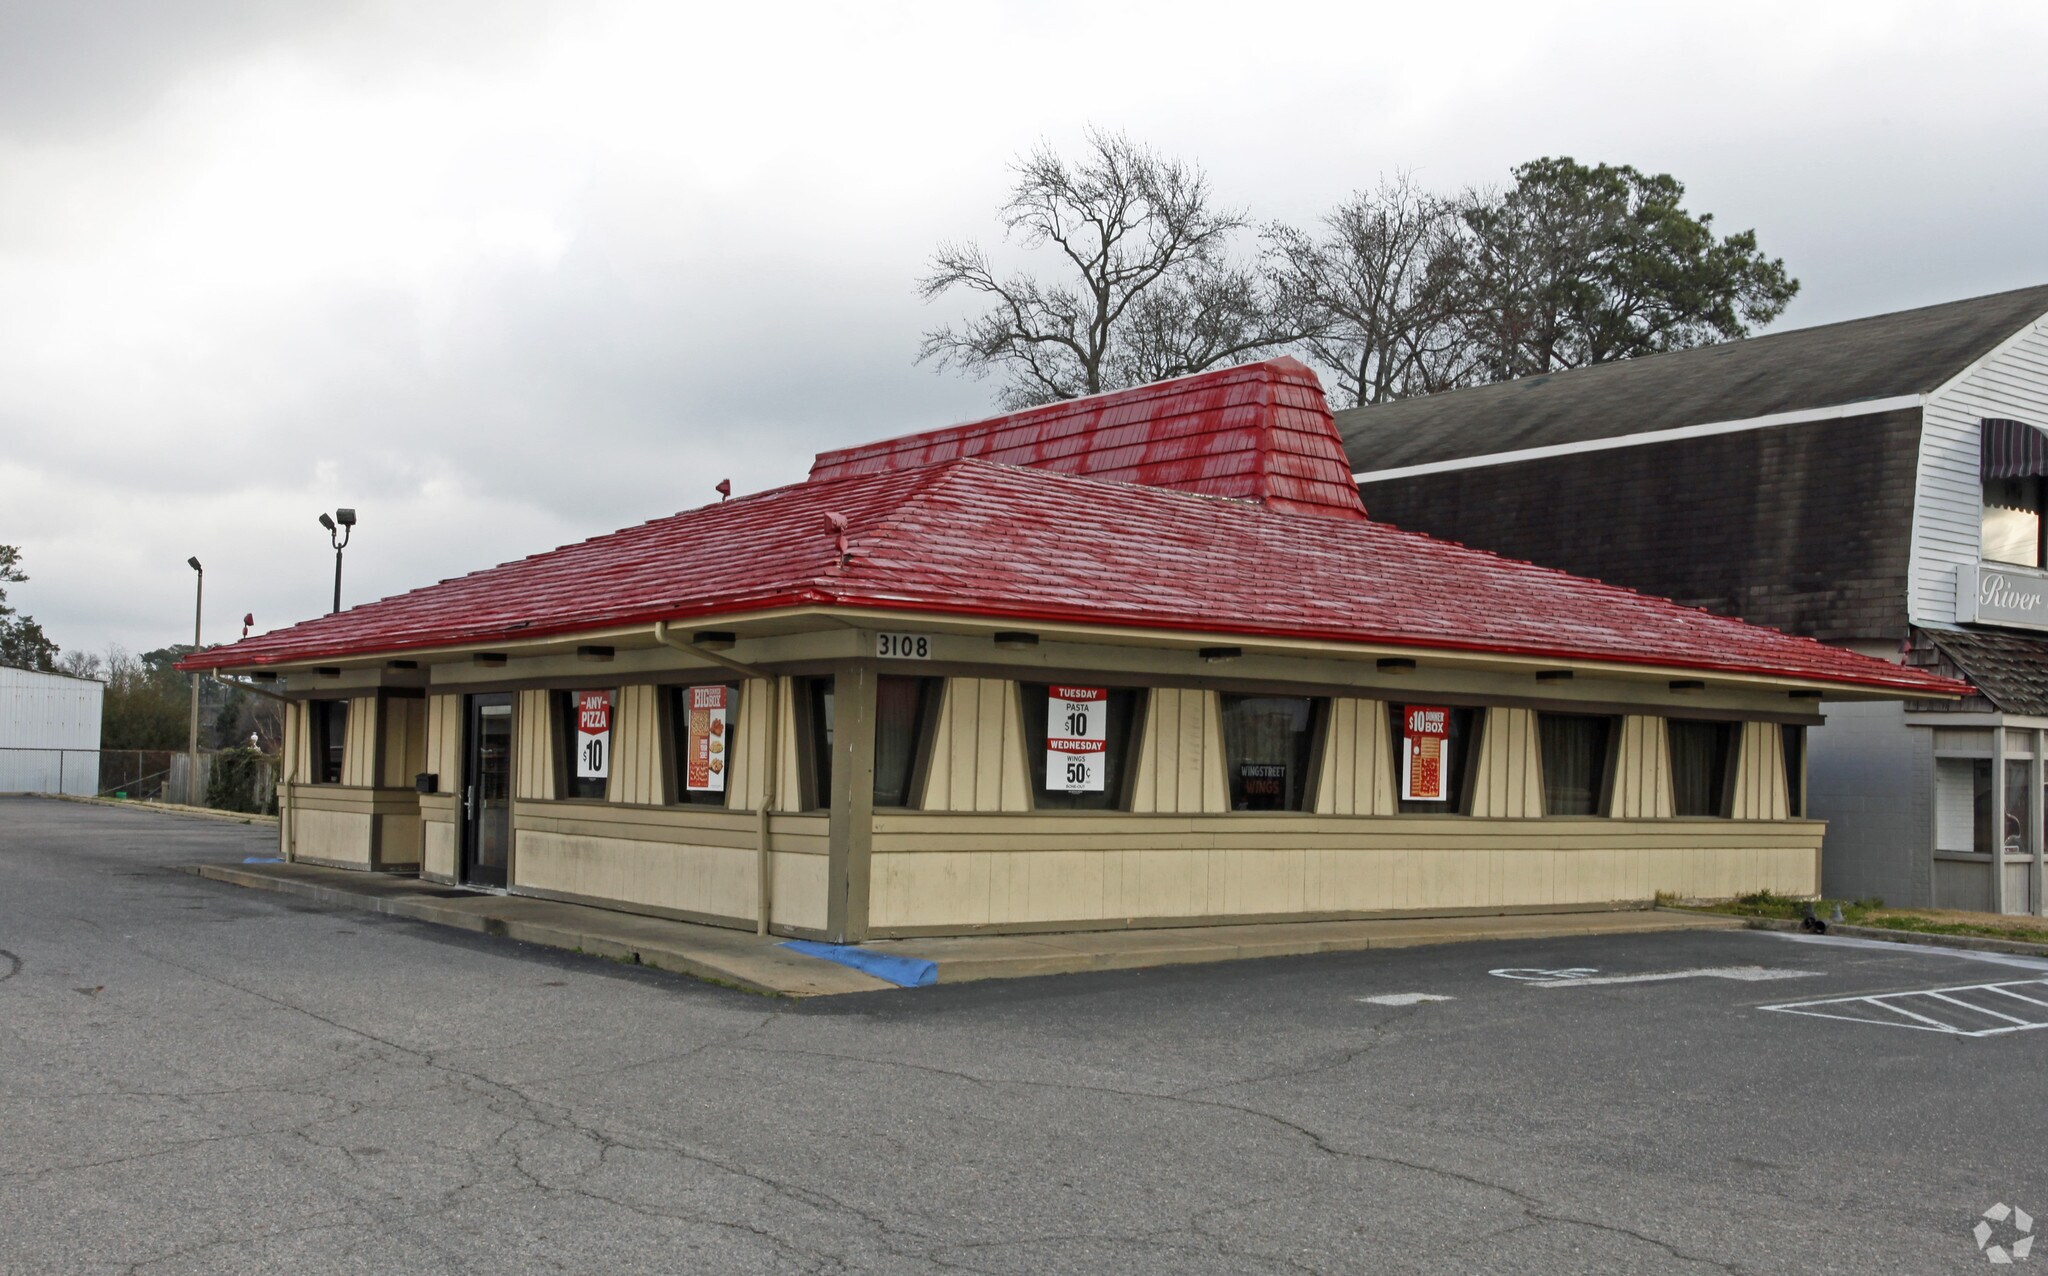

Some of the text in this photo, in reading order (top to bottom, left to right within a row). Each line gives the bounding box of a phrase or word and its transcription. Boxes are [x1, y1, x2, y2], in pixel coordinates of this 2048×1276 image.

[1980, 573, 2042, 610] River
[879, 634, 928, 657] 3108
[694, 688, 709, 708] BIG
[709, 695, 721, 707] BOX
[1058, 688, 1098, 699] TUESDAY
[1066, 703, 1090, 712] PASTA
[581, 711, 607, 728] PIZZA
[1064, 712, 1087, 736] $10
[1409, 711, 1425, 732] $10
[1425, 722, 1444, 733] BOX
[1050, 740, 1103, 750] WEDNESDAY
[583, 739, 603, 772] $10
[1241, 765, 1286, 777] WINGSTREET
[1247, 779, 1280, 794] WINGS
